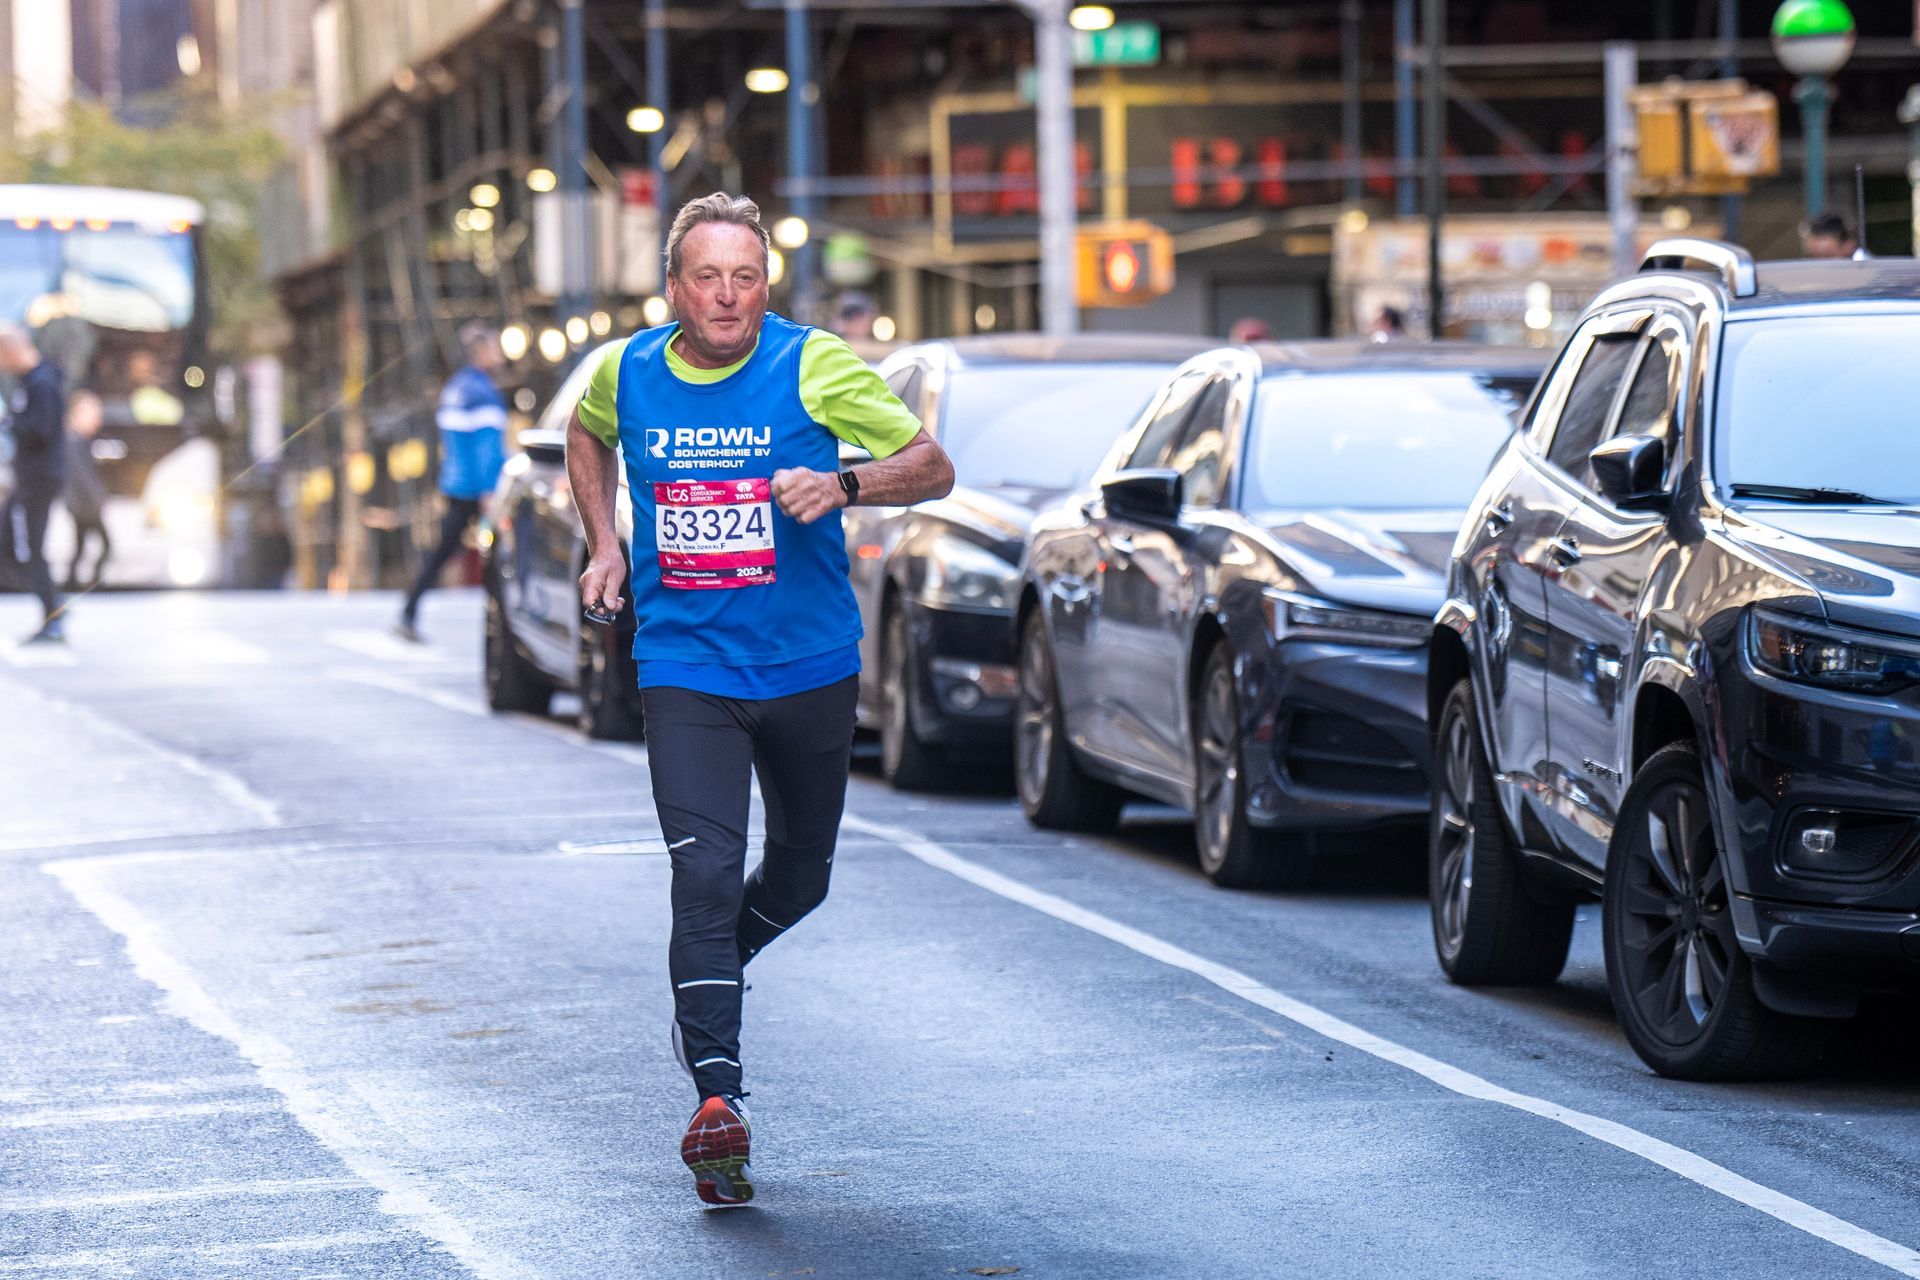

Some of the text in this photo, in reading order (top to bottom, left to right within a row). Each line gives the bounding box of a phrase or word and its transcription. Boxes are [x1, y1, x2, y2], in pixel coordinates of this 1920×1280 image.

[675, 427, 771, 446] ROWIJ
[674, 448, 771, 457] BOUWCHEMIE BV
[668, 460, 745, 468] OOSTERHOUT
[663, 506, 766, 542] 53324
[736, 566, 763, 577] 2024
